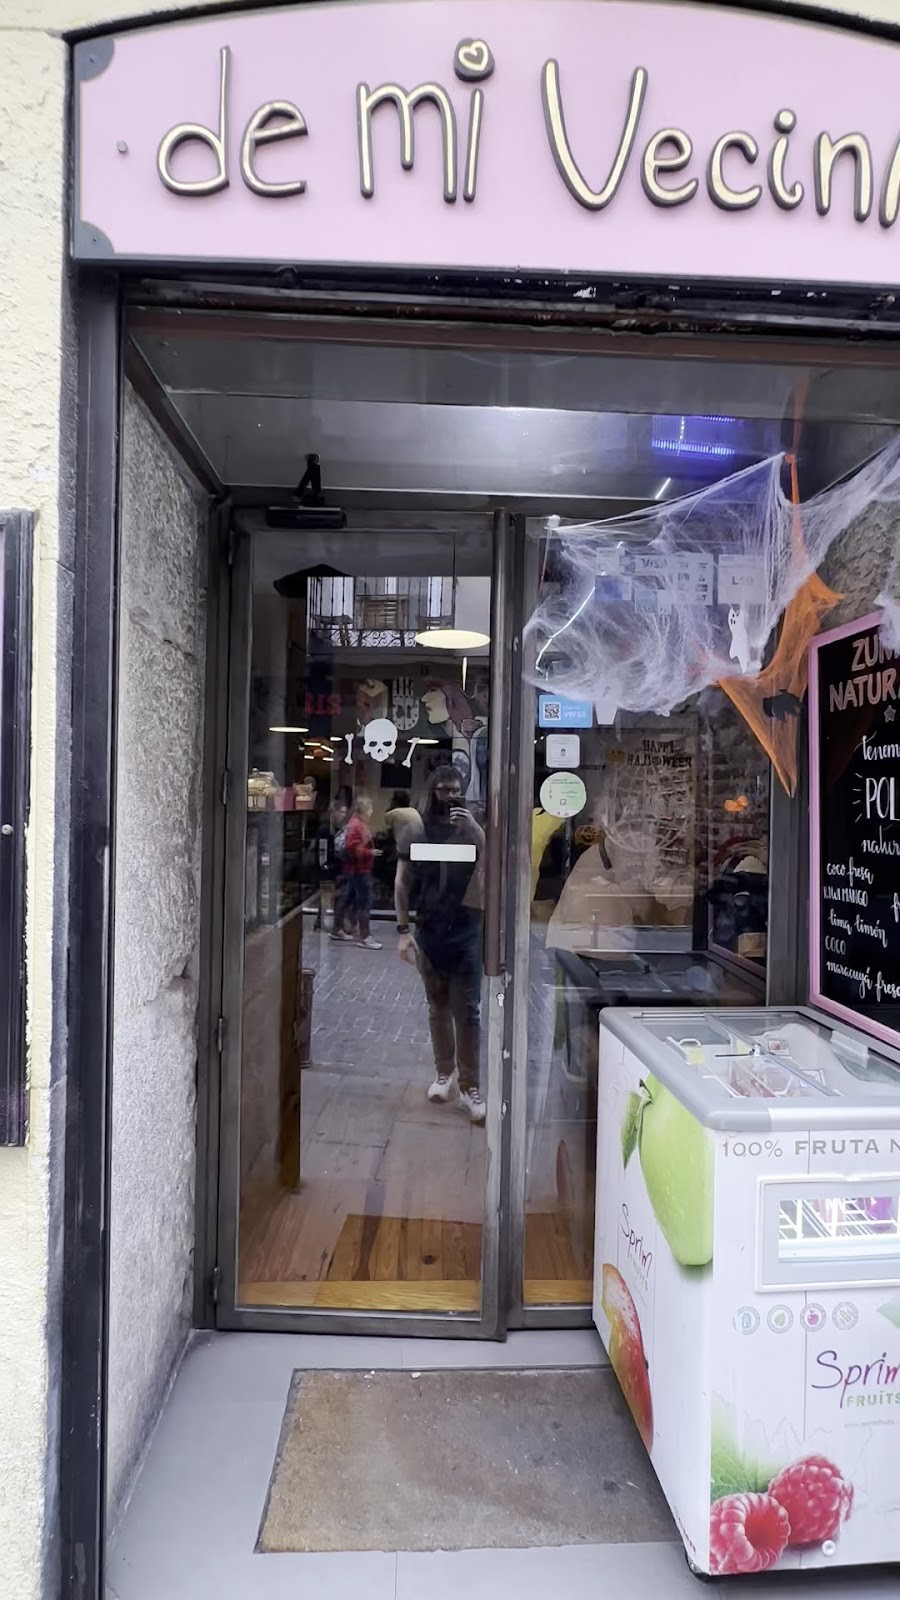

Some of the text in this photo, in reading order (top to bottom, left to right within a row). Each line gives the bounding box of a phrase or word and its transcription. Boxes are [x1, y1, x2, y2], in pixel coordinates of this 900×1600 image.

[156, 45, 308, 198] de
[357, 37, 496, 204] mi
[829, 668, 900, 712] NATUR
[826, 863, 846, 876] coco
[842, 887, 868, 907] MANGO
[723, 1139, 783, 1157] 100%
[795, 1138, 880, 1155] FRUTA
[620, 1203, 653, 1278] Sprim
